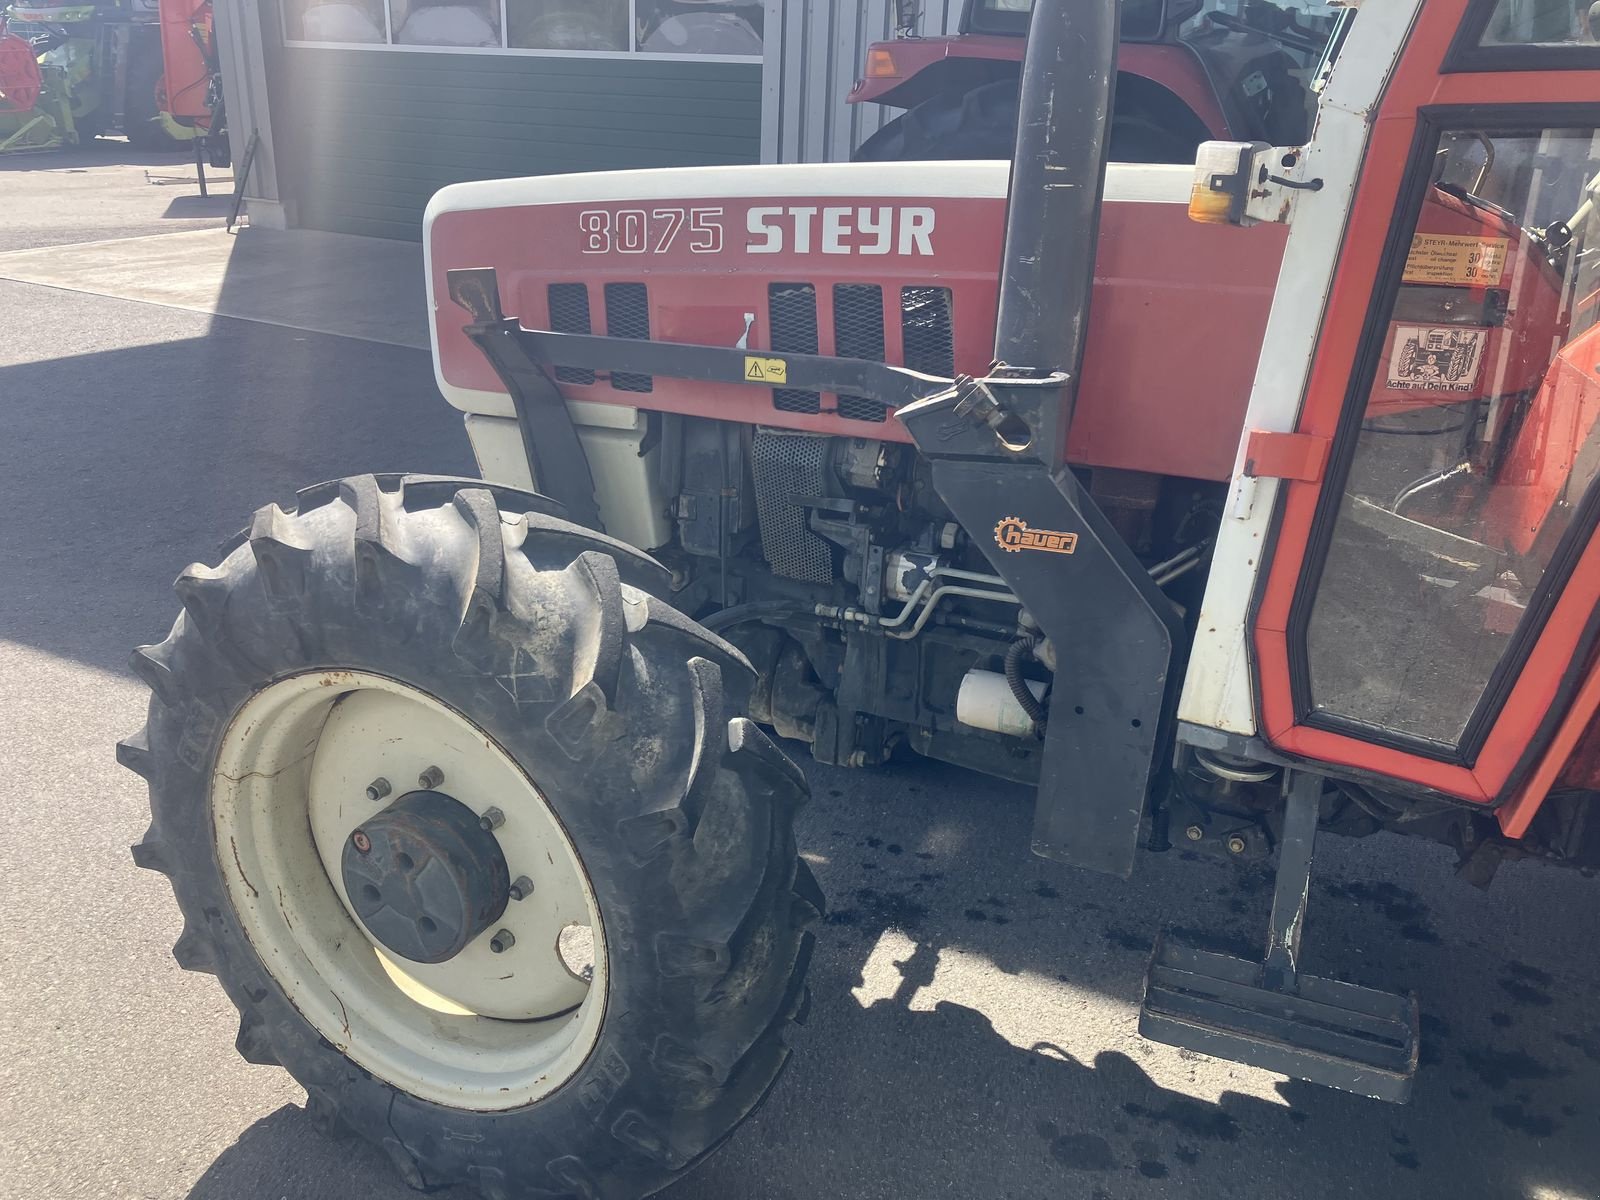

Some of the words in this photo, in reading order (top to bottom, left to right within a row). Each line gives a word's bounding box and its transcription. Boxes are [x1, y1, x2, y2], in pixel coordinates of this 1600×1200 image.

[579, 207, 723, 253] 8075
[746, 206, 936, 255] STEYR
[1468, 252, 1481, 264] 30
[1465, 266, 1478, 278] 30
[1386, 380, 1411, 389] Achte
[1411, 381, 1426, 390] auf
[1427, 382, 1447, 391] Dein
[1448, 383, 1473, 392] Kind!
[1005, 525, 1073, 549] hauer
